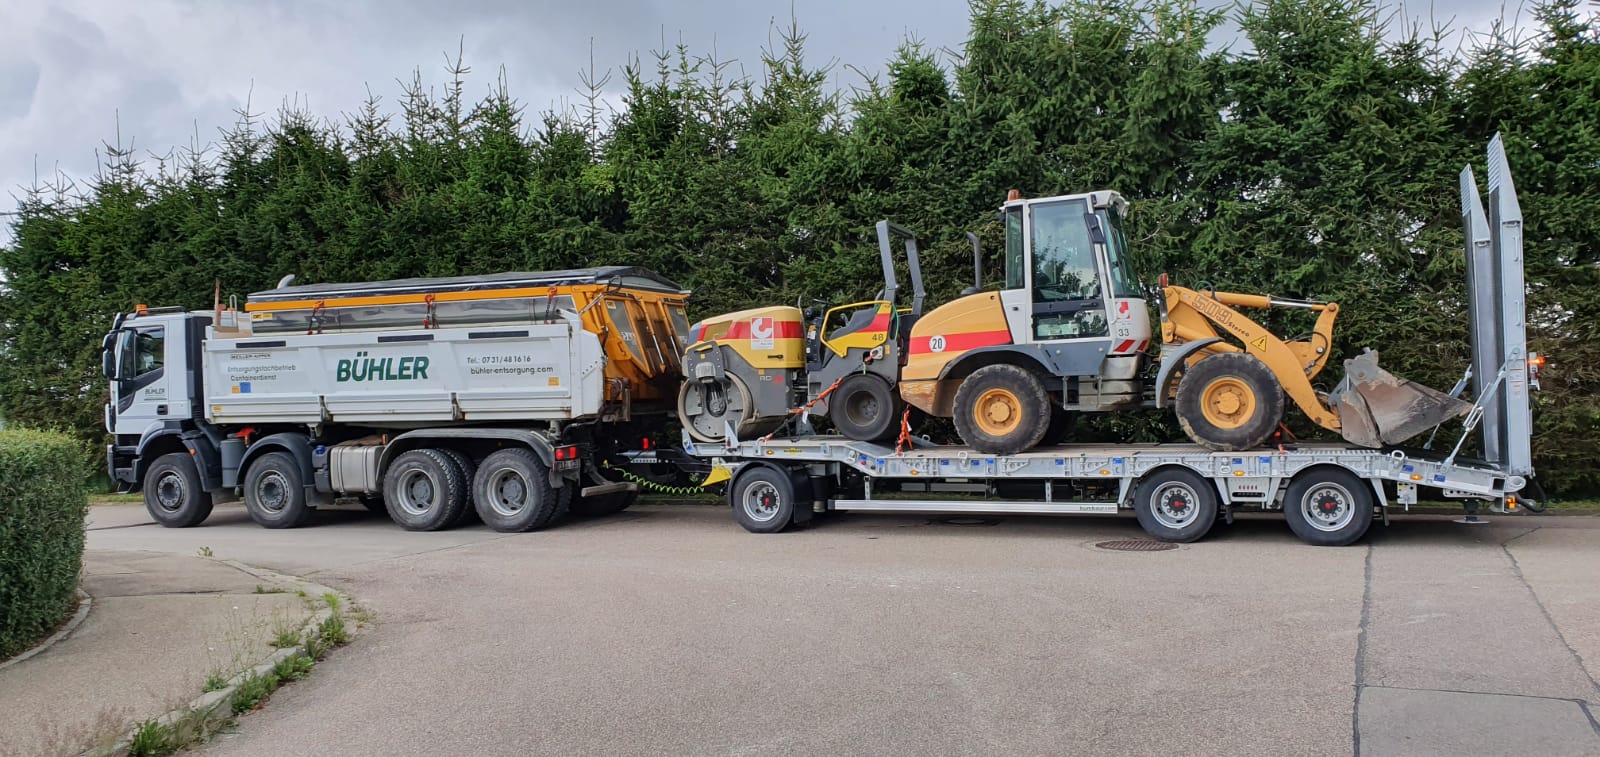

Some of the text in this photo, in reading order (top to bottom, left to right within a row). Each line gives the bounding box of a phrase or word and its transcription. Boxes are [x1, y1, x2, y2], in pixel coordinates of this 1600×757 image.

[872, 333, 884, 341] 48
[1118, 328, 1130, 337] 33
[932, 337, 943, 350] 20
[227, 364, 296, 374] Entsorgungsfachbetrieb
[336, 351, 430, 382] BÜHLER
[470, 366, 554, 375] bühler-entsorgung.com
